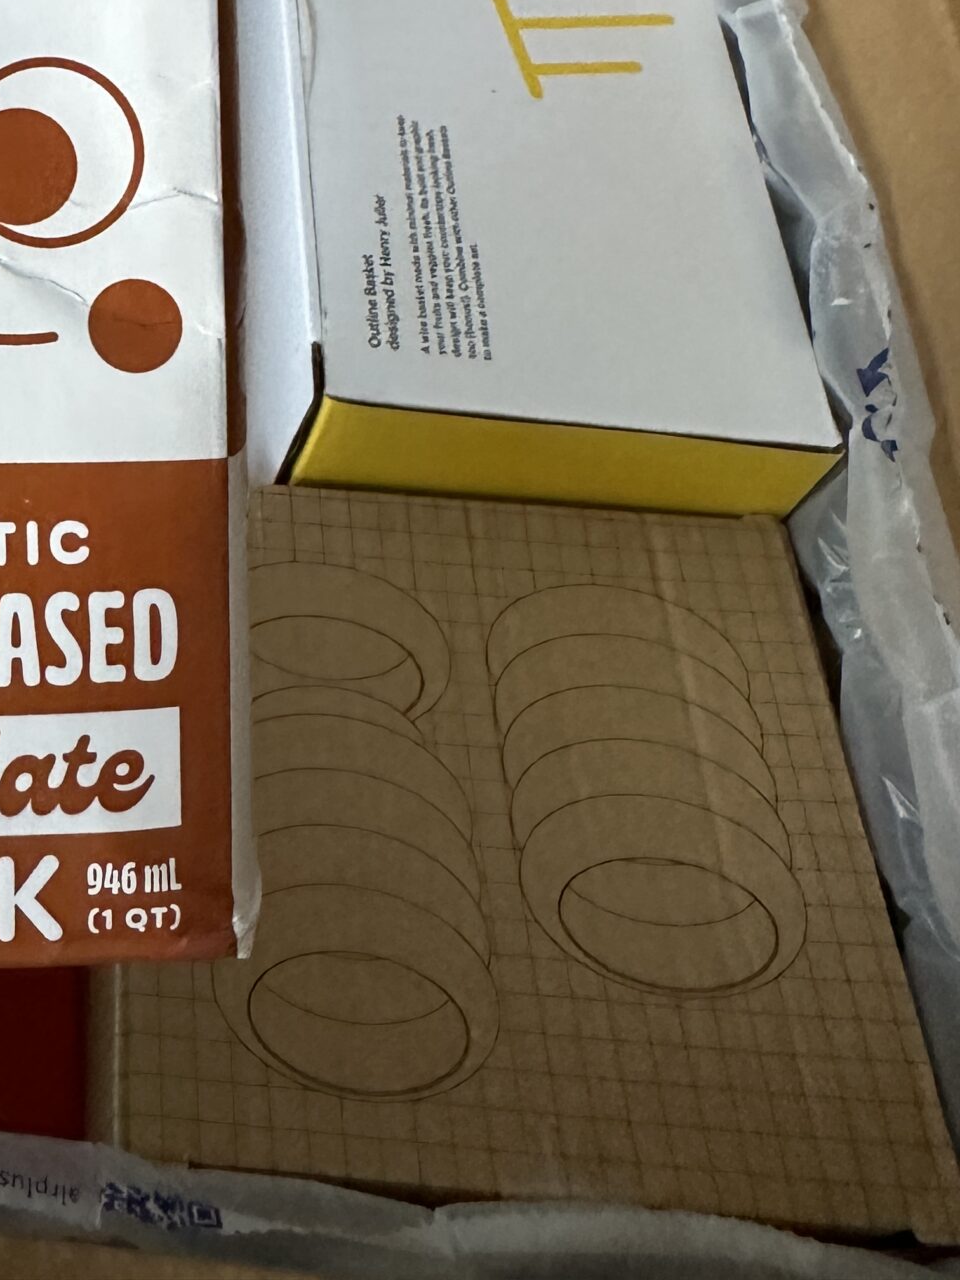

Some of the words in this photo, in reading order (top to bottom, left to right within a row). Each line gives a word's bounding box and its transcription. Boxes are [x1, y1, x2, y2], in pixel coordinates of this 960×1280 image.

[378, 229, 393, 266] Henry
[362, 253, 377, 296] Basket
[382, 269, 395, 285] by
[367, 298, 381, 348] Outline
[385, 288, 400, 351] designed
[87, 862, 137, 895] 946
[88, 908, 112, 933] (1
[126, 904, 180, 932] QT)
